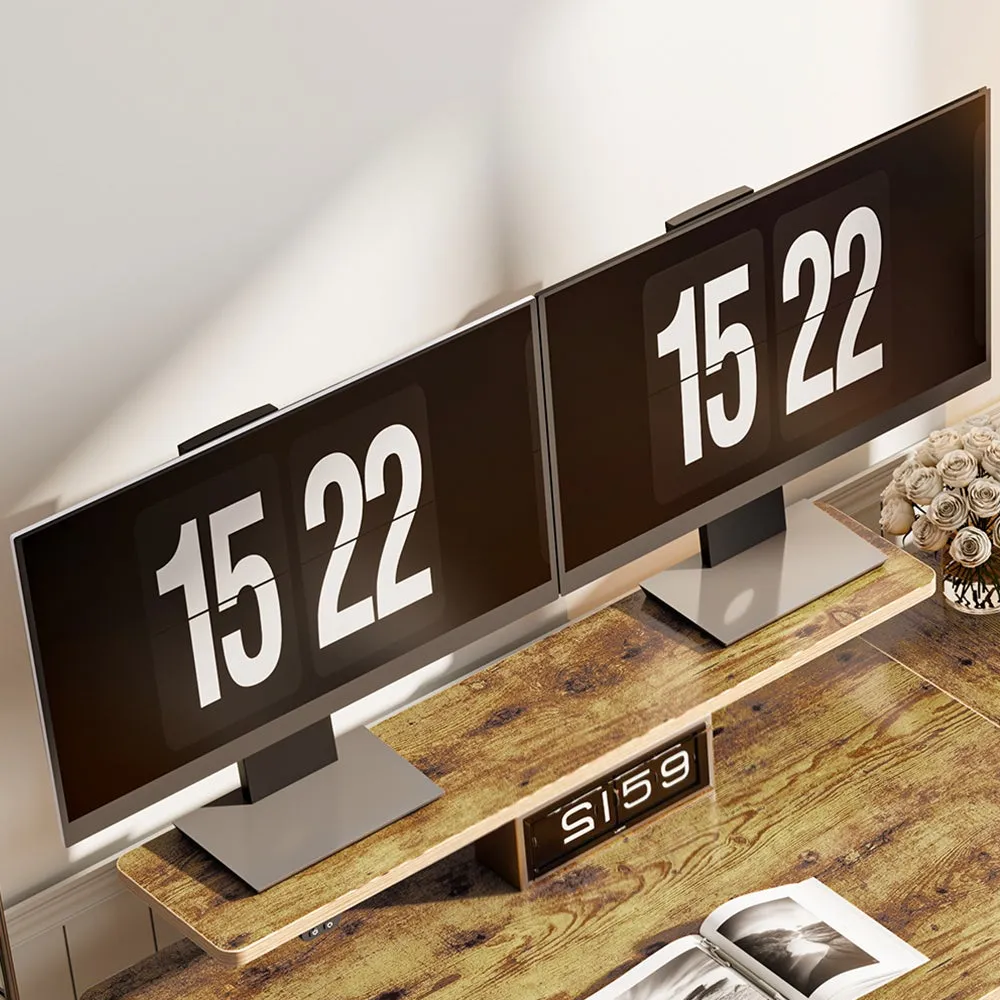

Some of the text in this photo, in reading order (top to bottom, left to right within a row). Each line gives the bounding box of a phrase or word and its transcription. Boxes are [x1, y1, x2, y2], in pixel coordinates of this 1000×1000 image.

[656, 207, 884, 466] 15 22
[156, 424, 434, 709] 15 22
